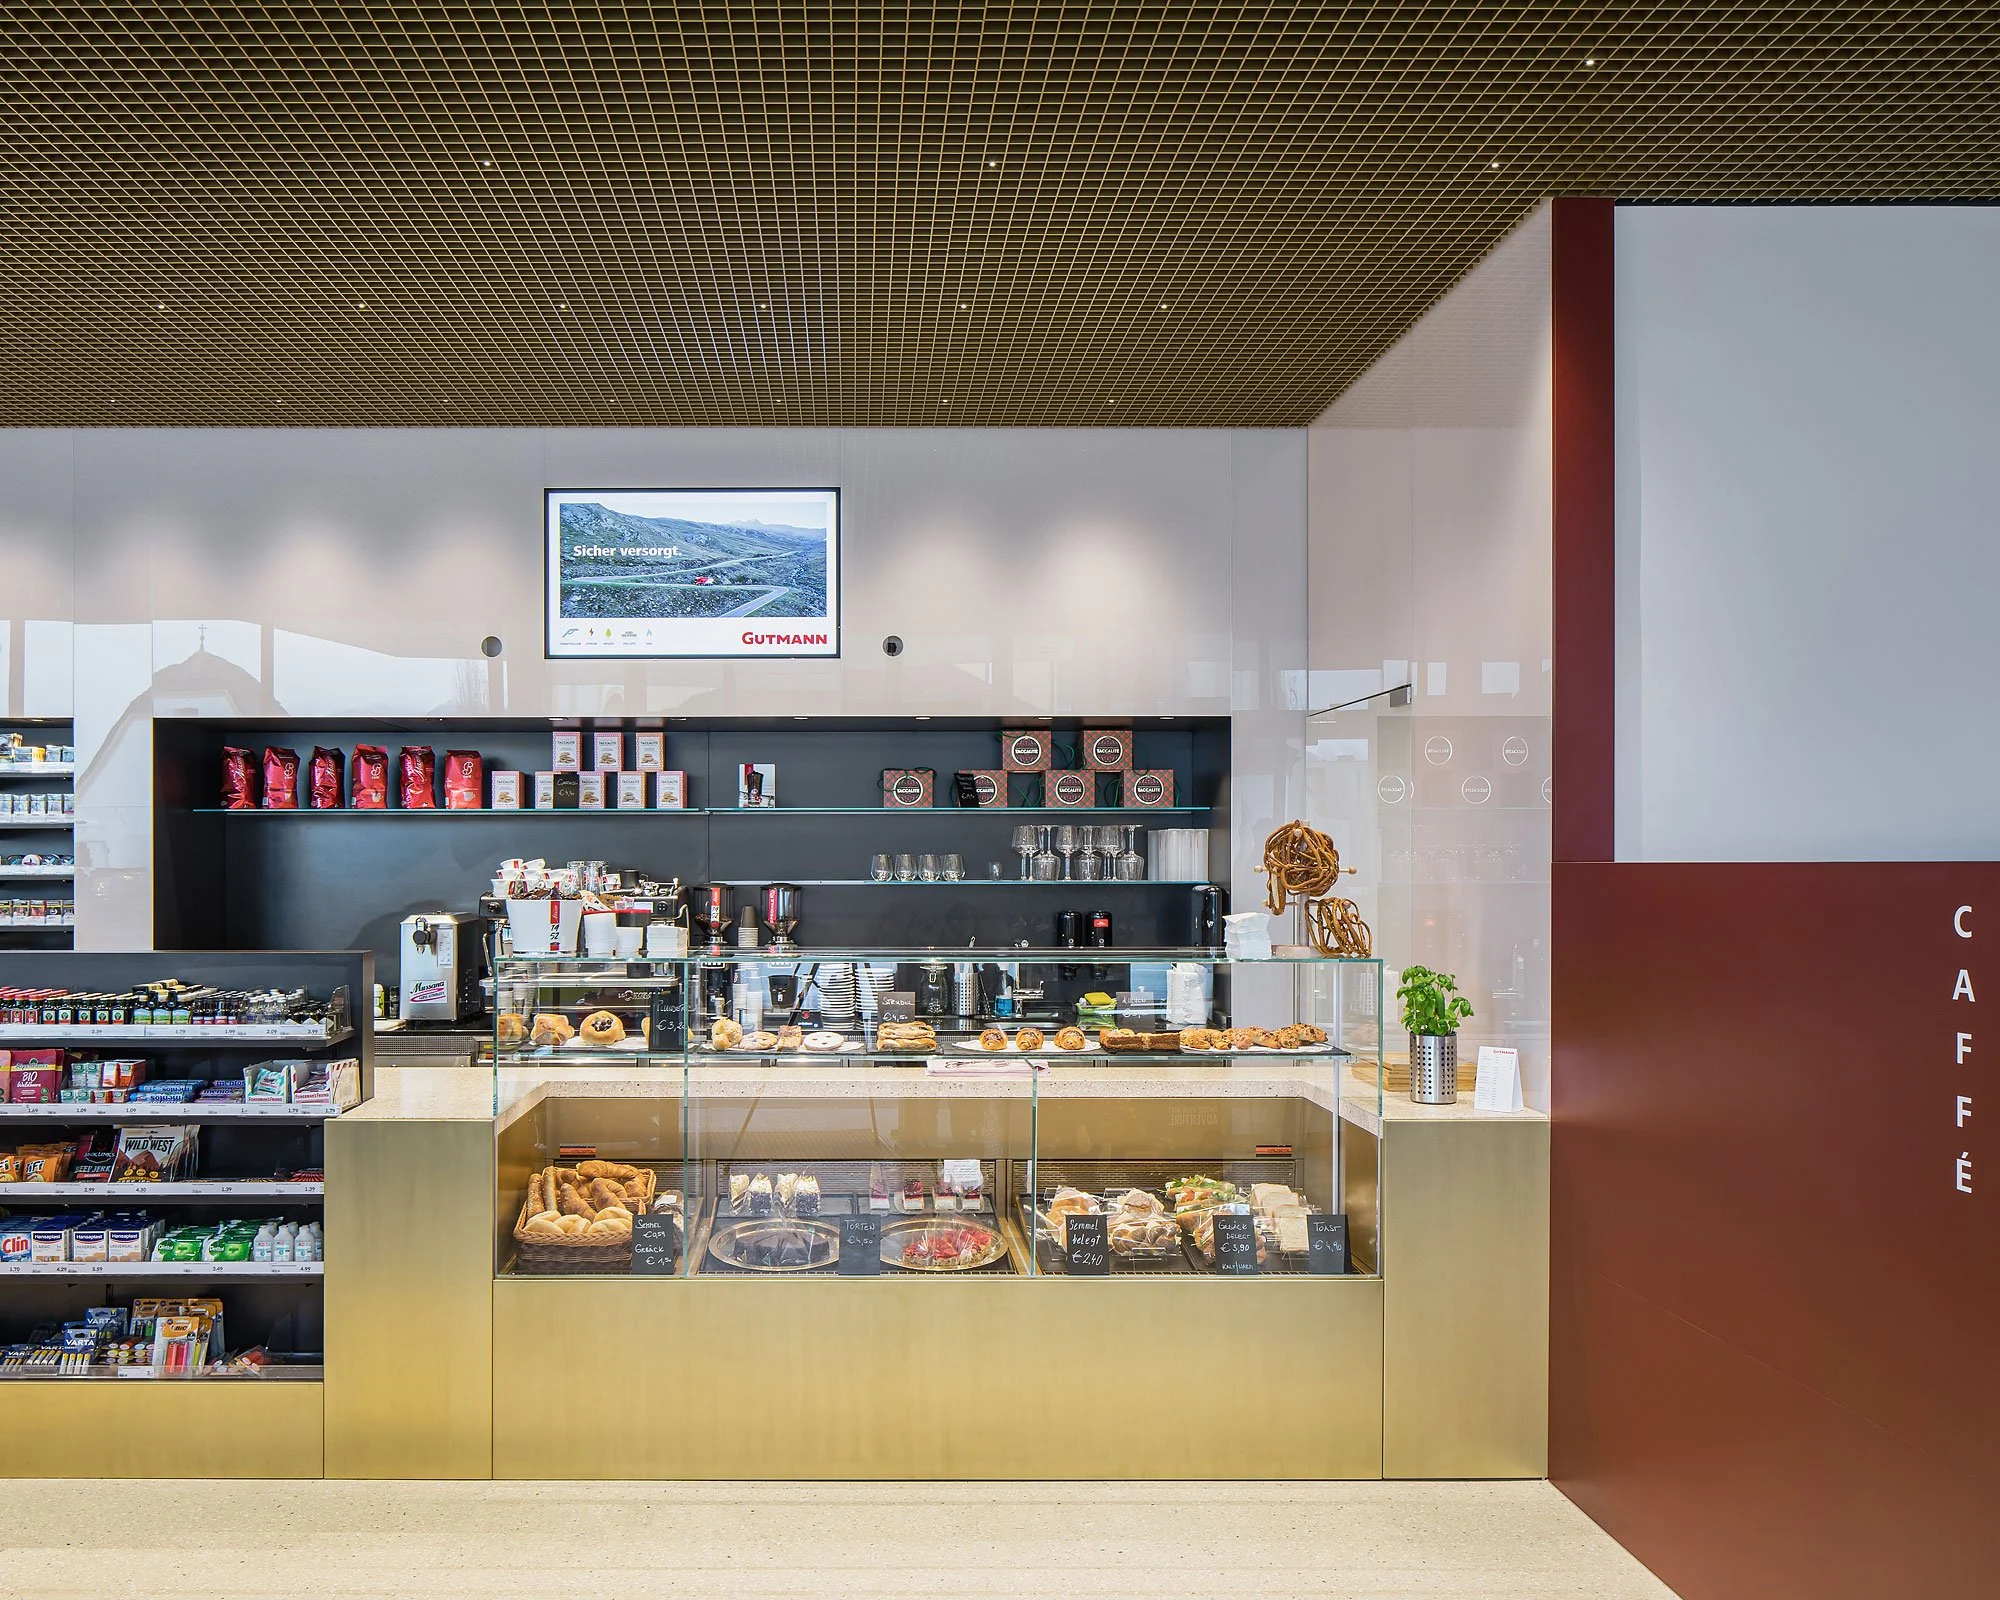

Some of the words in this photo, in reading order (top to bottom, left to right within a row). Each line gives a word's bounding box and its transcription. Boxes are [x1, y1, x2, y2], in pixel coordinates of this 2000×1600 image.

[573, 545, 617, 557] Sicher
[619, 546, 683, 558] versorgt.
[741, 632, 828, 645] GUTMANN
[1952, 905, 1976, 1194] CAFFÉ
[22, 1071, 38, 1082] BIO
[125, 1138, 149, 1153] WILD
[150, 1139, 175, 1154] WEST
[844, 1219, 875, 1231] TORTEN
[2, 1236, 30, 1254] Clin
